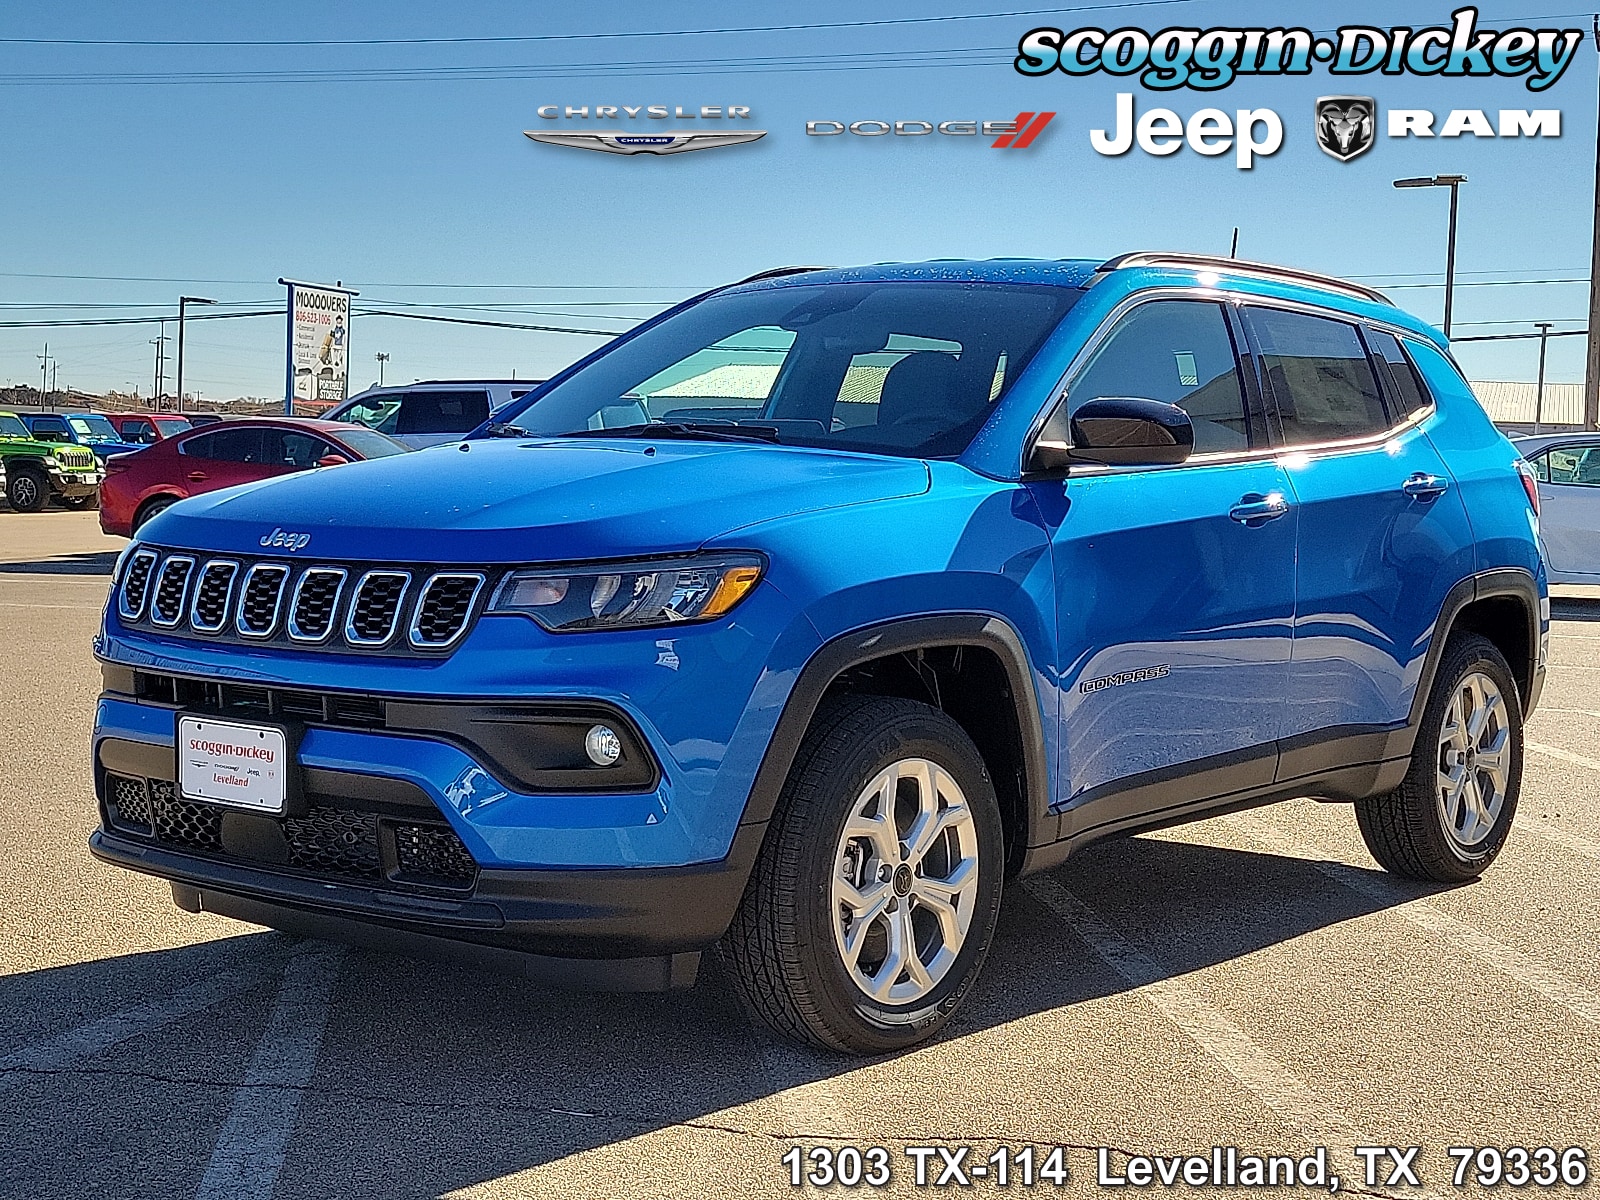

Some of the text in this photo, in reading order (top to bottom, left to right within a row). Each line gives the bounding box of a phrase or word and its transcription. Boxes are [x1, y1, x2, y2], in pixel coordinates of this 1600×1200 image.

[296, 291, 347, 313] MOOOOVERS
[319, 390, 343, 400] STORAGE
[260, 527, 310, 552] Jeep
[1080, 664, 1171, 694] COMPASS
[213, 773, 249, 787] Levelland
